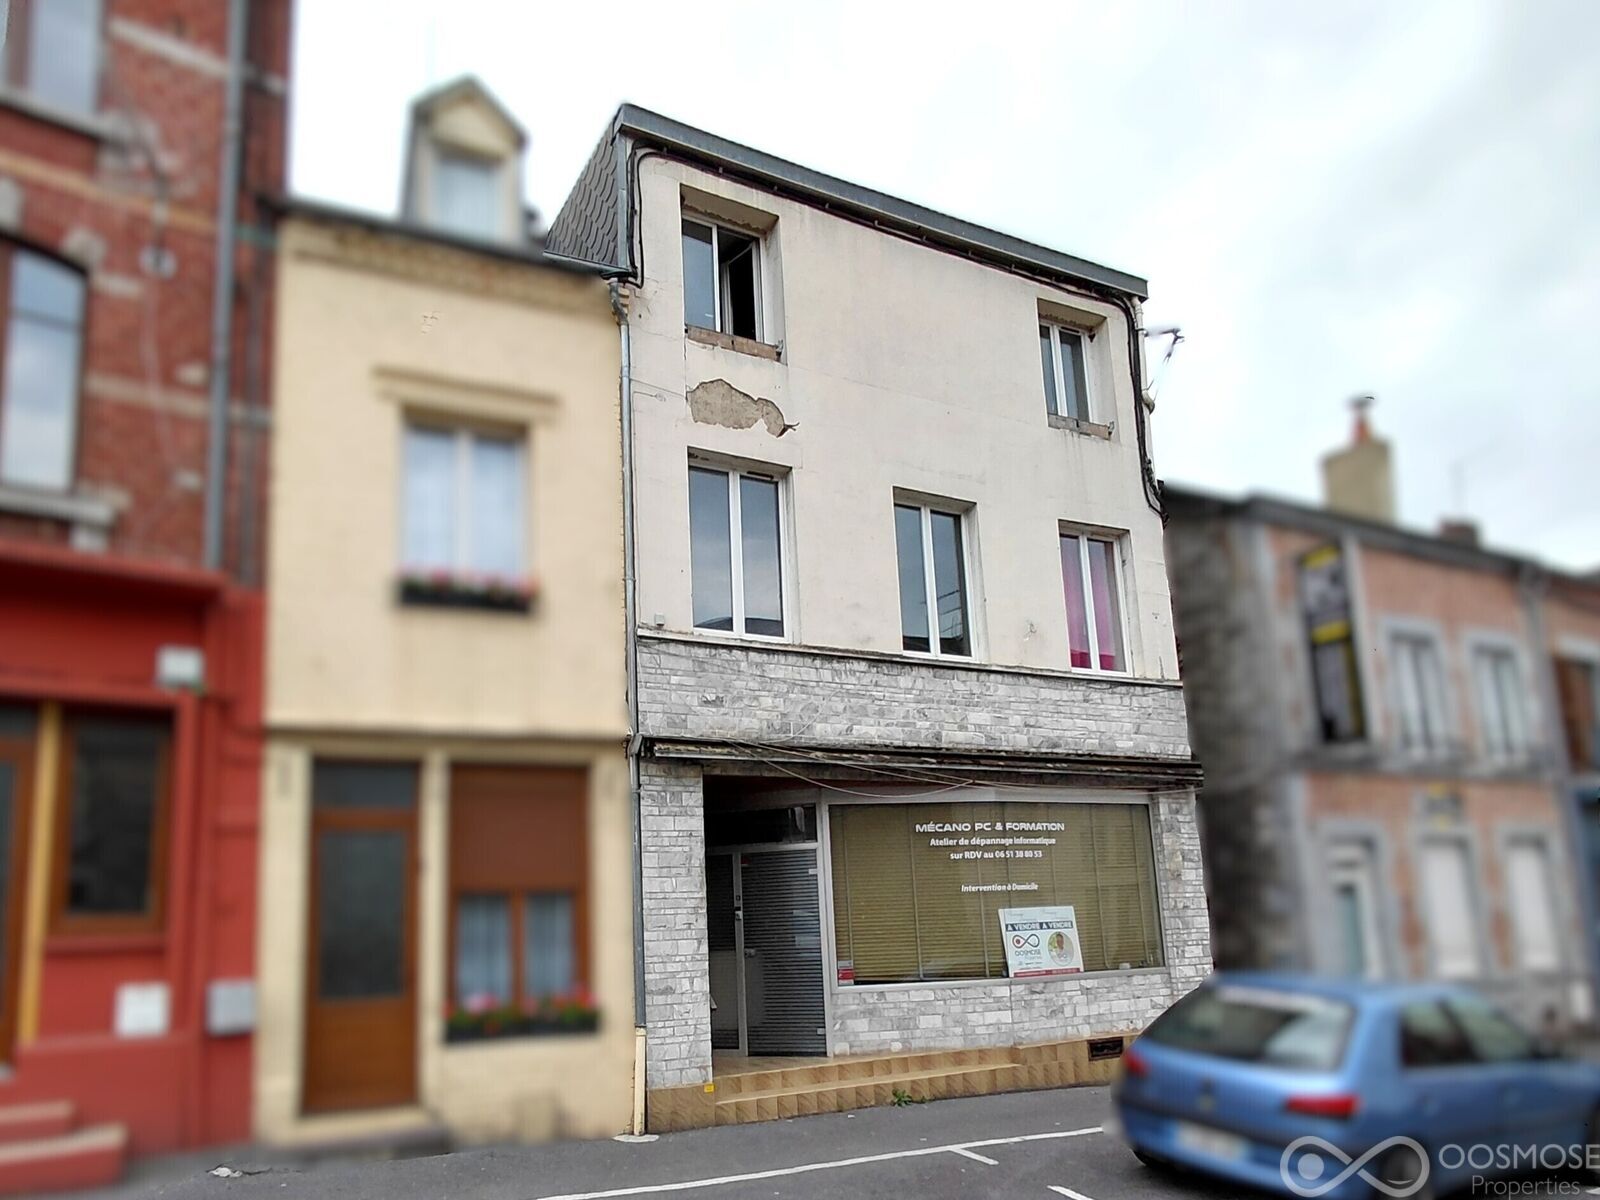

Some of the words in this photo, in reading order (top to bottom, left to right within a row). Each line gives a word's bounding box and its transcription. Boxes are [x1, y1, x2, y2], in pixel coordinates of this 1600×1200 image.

[915, 821, 971, 832] MÉCANO
[974, 822, 992, 831] PC
[994, 822, 1003, 831] &
[1005, 822, 1065, 831] FORMATION
[929, 837, 957, 846] Atelier
[958, 837, 969, 845] de
[970, 836, 1013, 846] dépannage
[1013, 836, 1056, 846] informatique
[964, 851, 982, 859] RDV
[994, 850, 1005, 858] 06
[1005, 850, 1014, 858] 51
[961, 883, 1006, 892] Intervention
